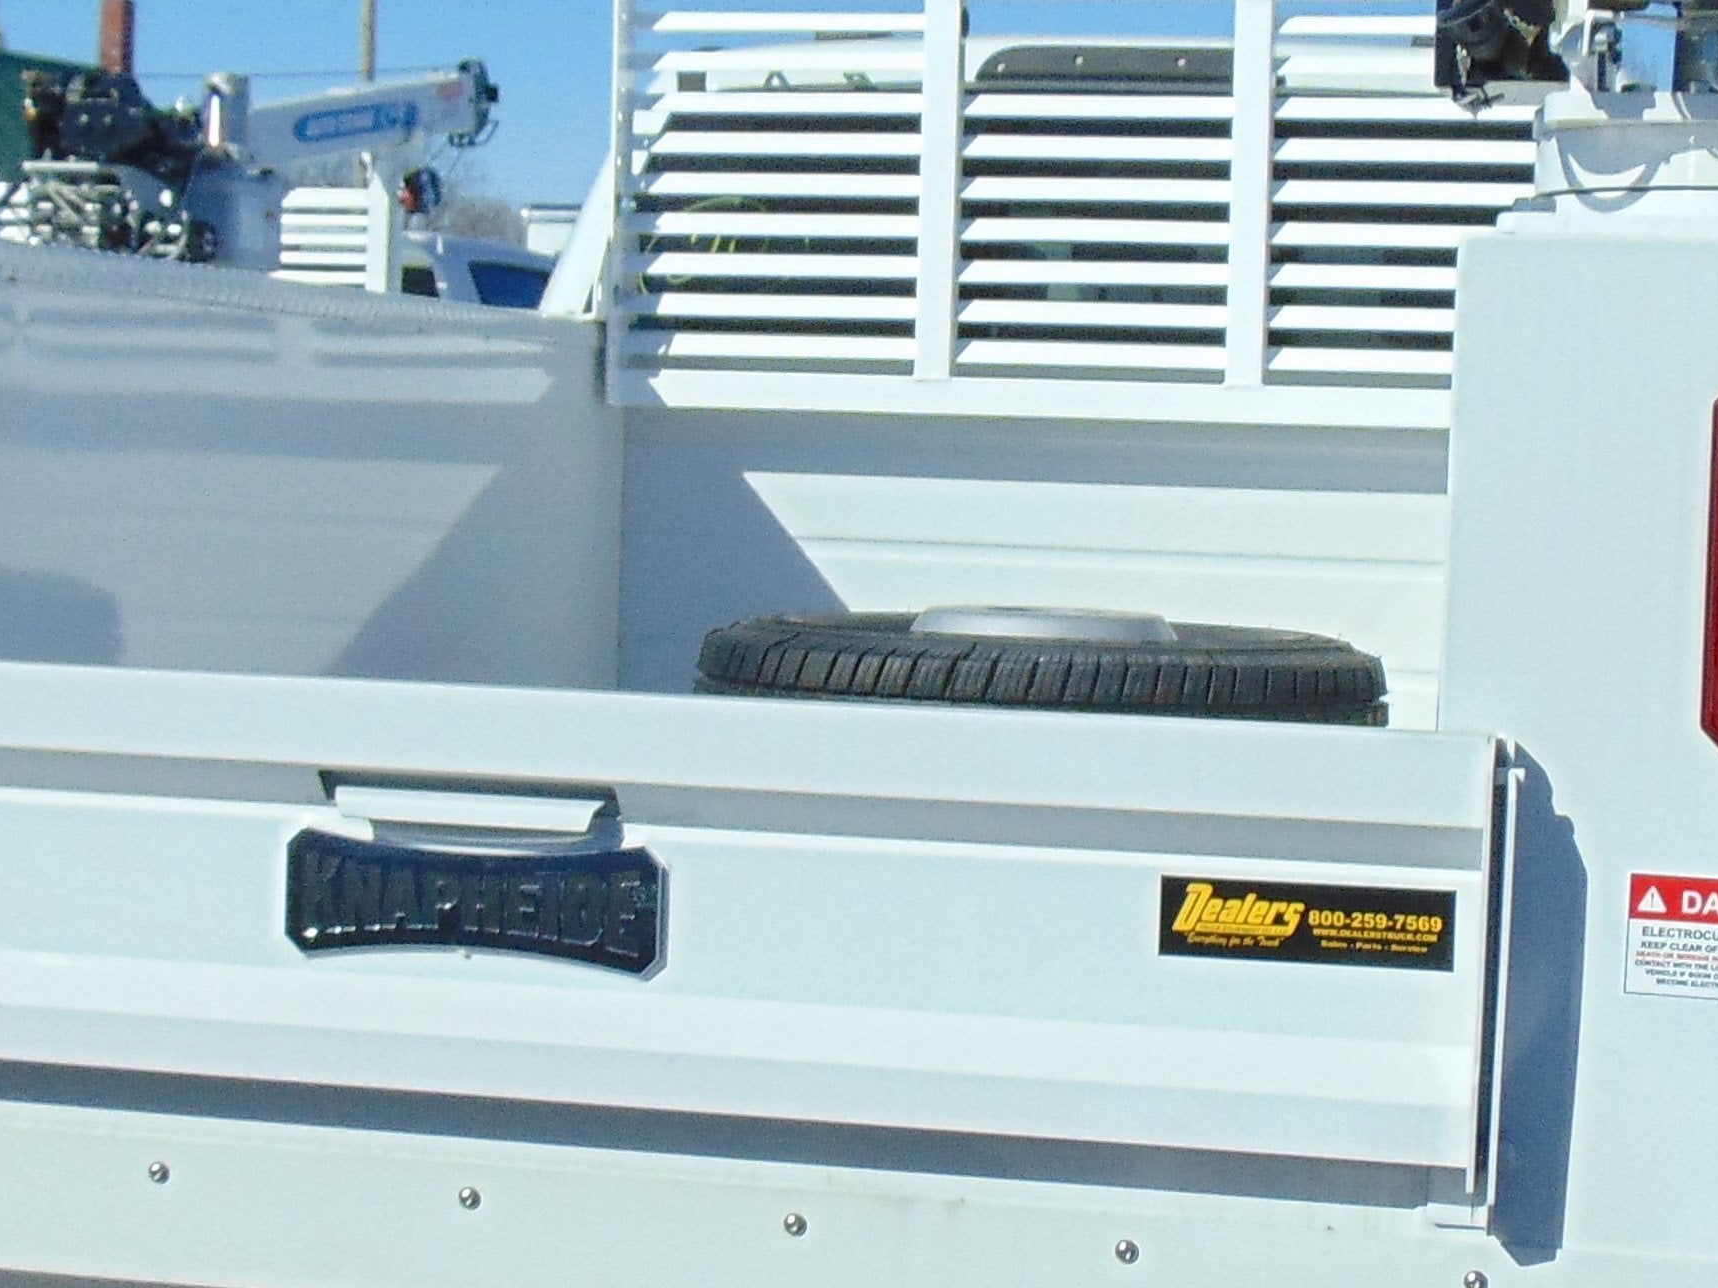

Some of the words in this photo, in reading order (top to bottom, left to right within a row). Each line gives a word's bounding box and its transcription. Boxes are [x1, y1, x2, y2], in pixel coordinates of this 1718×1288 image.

[1172, 882, 1306, 937] Dealers
[1308, 909, 1442, 932] 800-259-7569
[1641, 941, 1667, 950] KEEP
[1669, 942, 1702, 952] CLEAR
[1705, 945, 1718, 953] OF
[1634, 959, 1670, 968] CONTACT
[1694, 963, 1708, 971] THE
